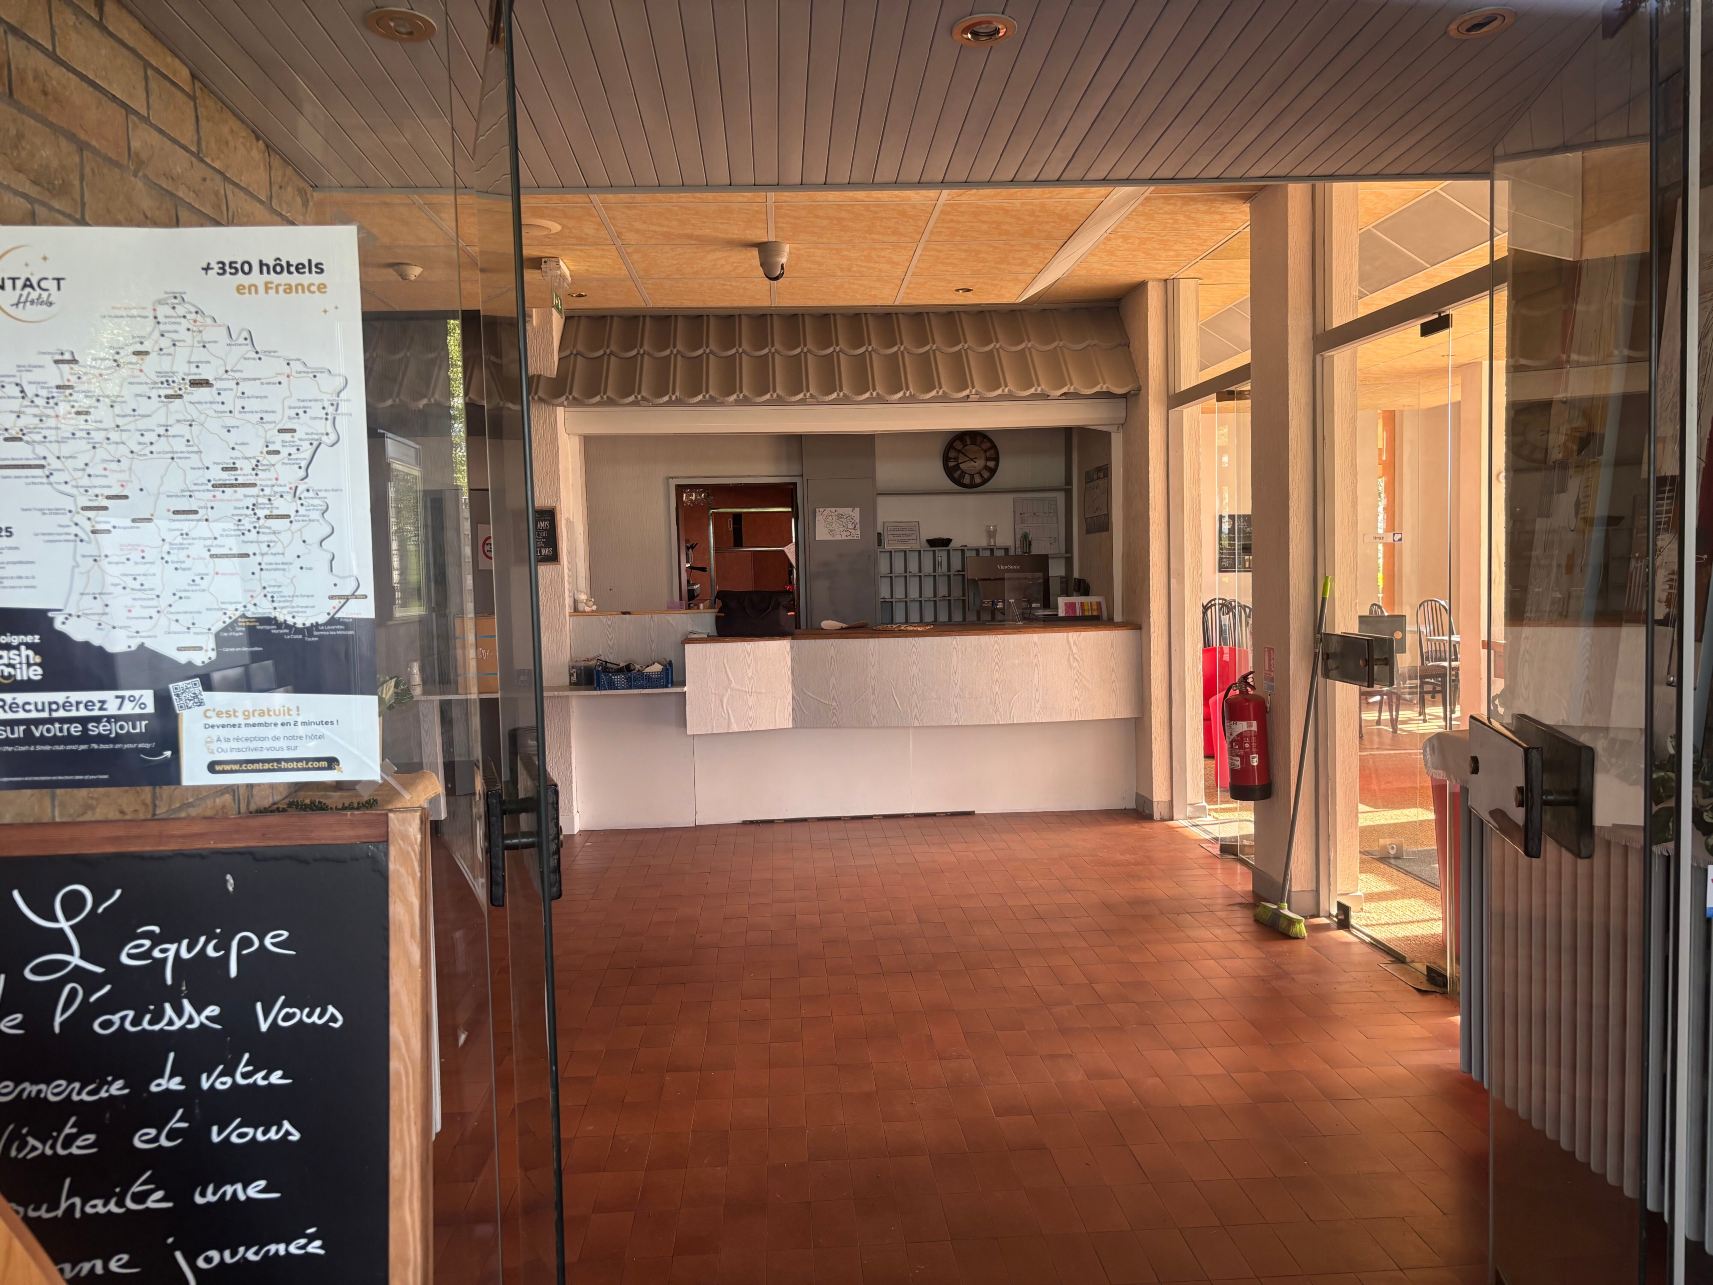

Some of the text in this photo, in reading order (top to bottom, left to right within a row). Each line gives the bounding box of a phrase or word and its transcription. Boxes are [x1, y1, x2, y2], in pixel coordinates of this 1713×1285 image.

[201, 257, 325, 276] +350 hôtels
[236, 281, 328, 295] en France
[115, 694, 147, 711] 7%
[203, 707, 239, 719] C'est
[242, 706, 293, 720] gratuit
[30, 722, 83, 737] votre
[87, 718, 149, 738] séjour
[204, 722, 243, 730] Devenez
[244, 720, 279, 728] membre
[300, 719, 335, 727] minutes
[232, 735, 270, 744] réception
[214, 760, 328, 771] www.contact-hotel.com
[149, 1051, 187, 1093] de
[132, 1108, 190, 1149] et
[193, 1179, 282, 1205] une
